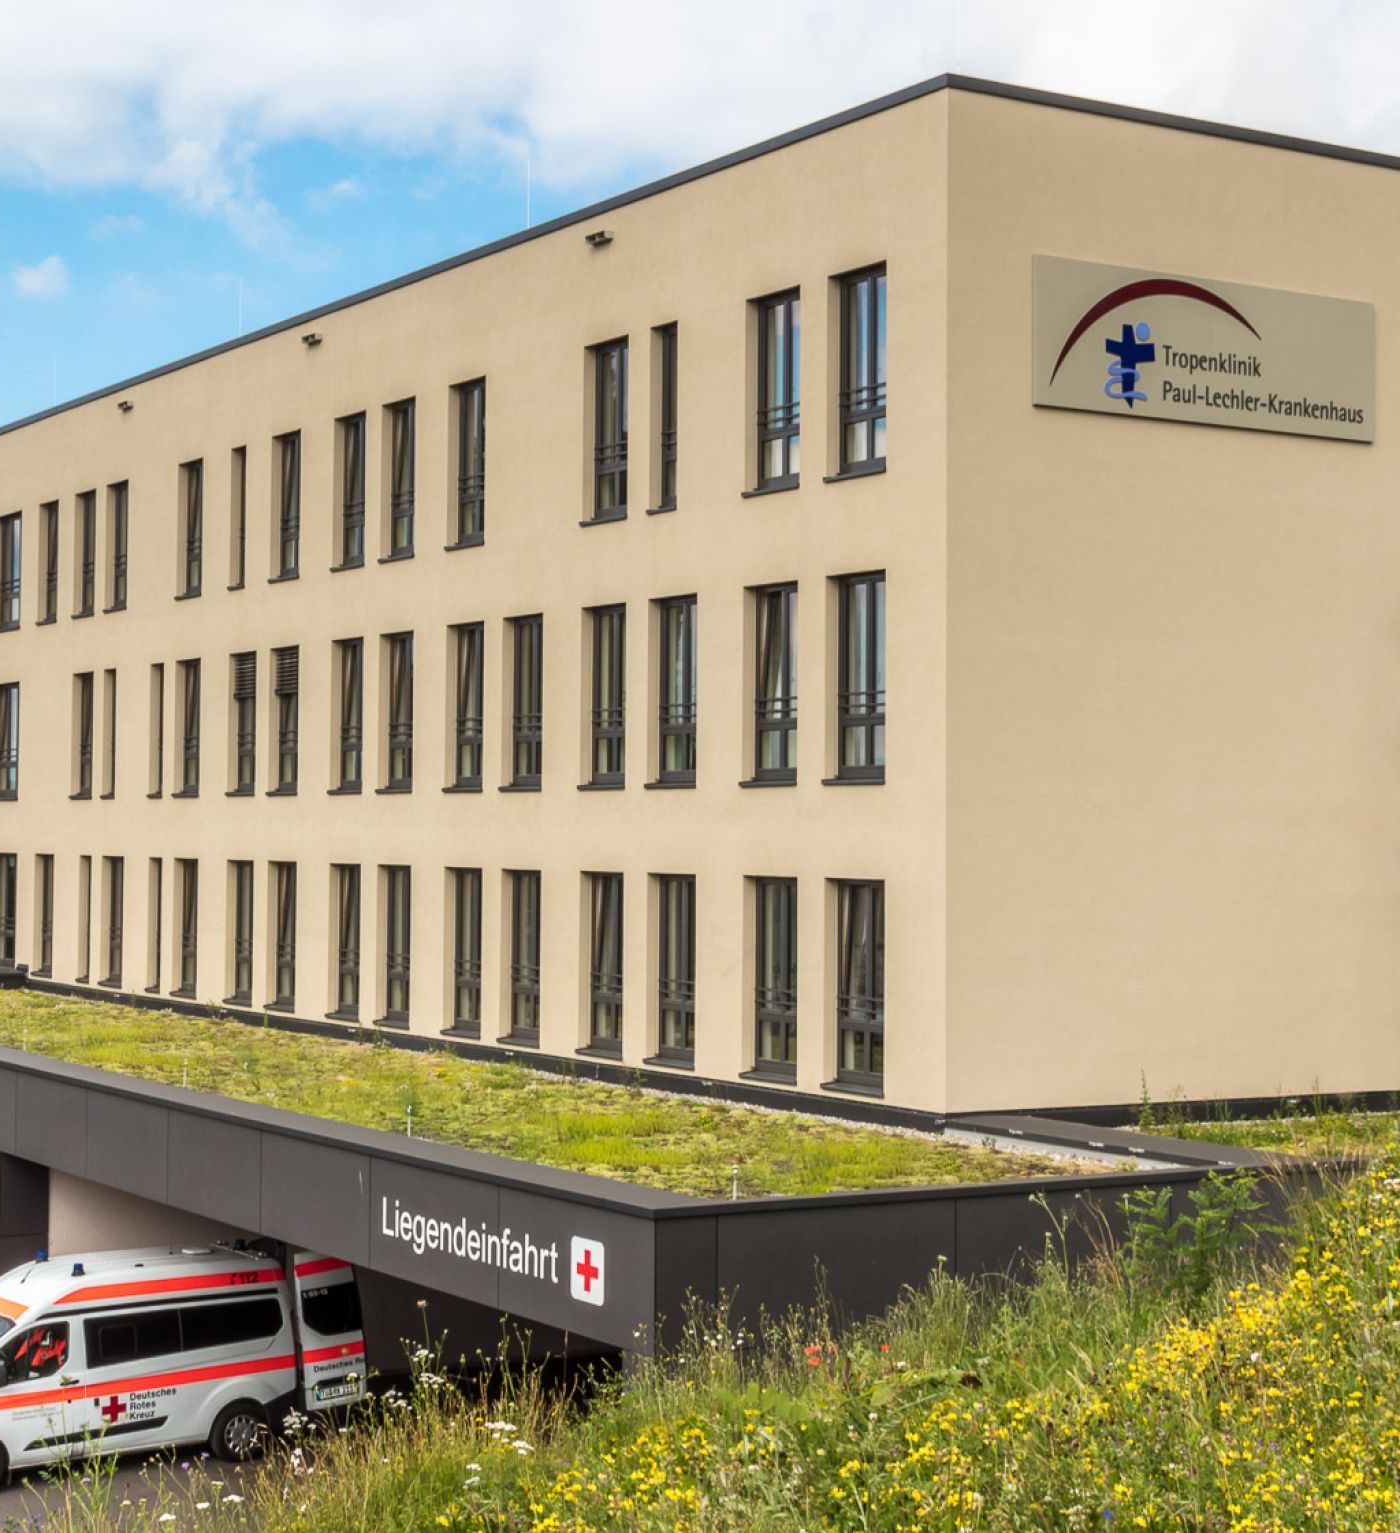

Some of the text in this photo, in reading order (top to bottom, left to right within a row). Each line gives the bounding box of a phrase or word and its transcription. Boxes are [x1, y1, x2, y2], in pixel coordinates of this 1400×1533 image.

[1162, 345, 1262, 378] Tropenklinik
[1162, 381, 1364, 424] Paul-Lechler-Krankenhaus
[382, 1196, 558, 1283] Liegendeinfahrt
[240, 1271, 259, 1284] 112
[130, 1388, 177, 1401] Deutsches
[130, 1401, 156, 1411] Rotes
[130, 1411, 155, 1420] Kreuz
